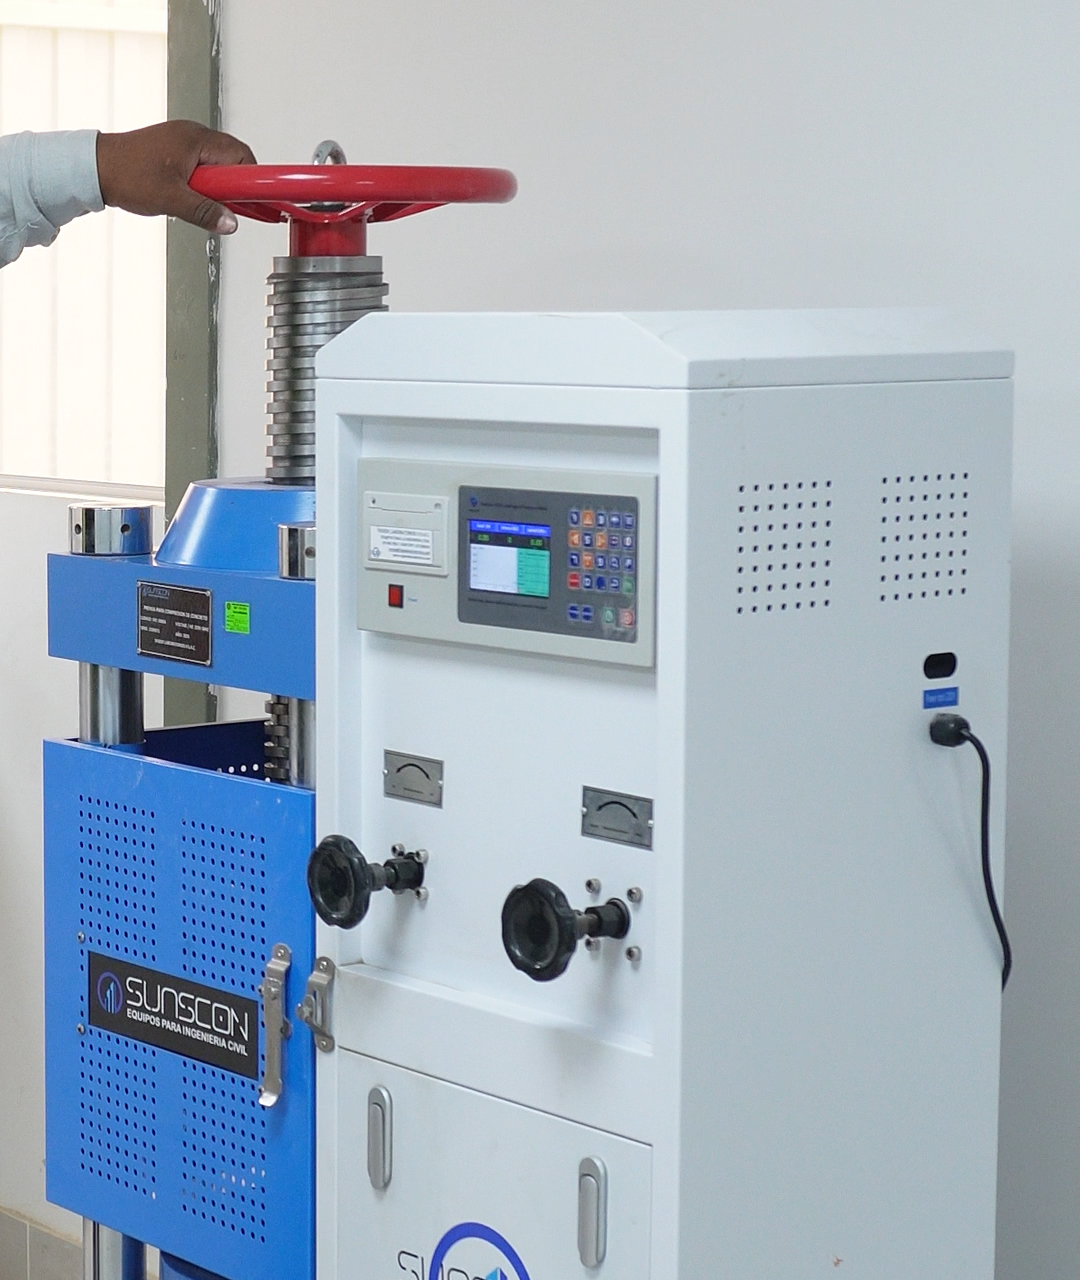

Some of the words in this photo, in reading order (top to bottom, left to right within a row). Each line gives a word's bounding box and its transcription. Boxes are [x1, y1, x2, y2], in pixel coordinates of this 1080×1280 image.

[125, 976, 249, 1042] SUNSCON
[126, 1008, 161, 1029] EQUIPOS
[161, 1017, 182, 1035] PARA
[182, 1025, 227, 1050] INGENIERIA
[227, 1039, 248, 1057] CIVIL
